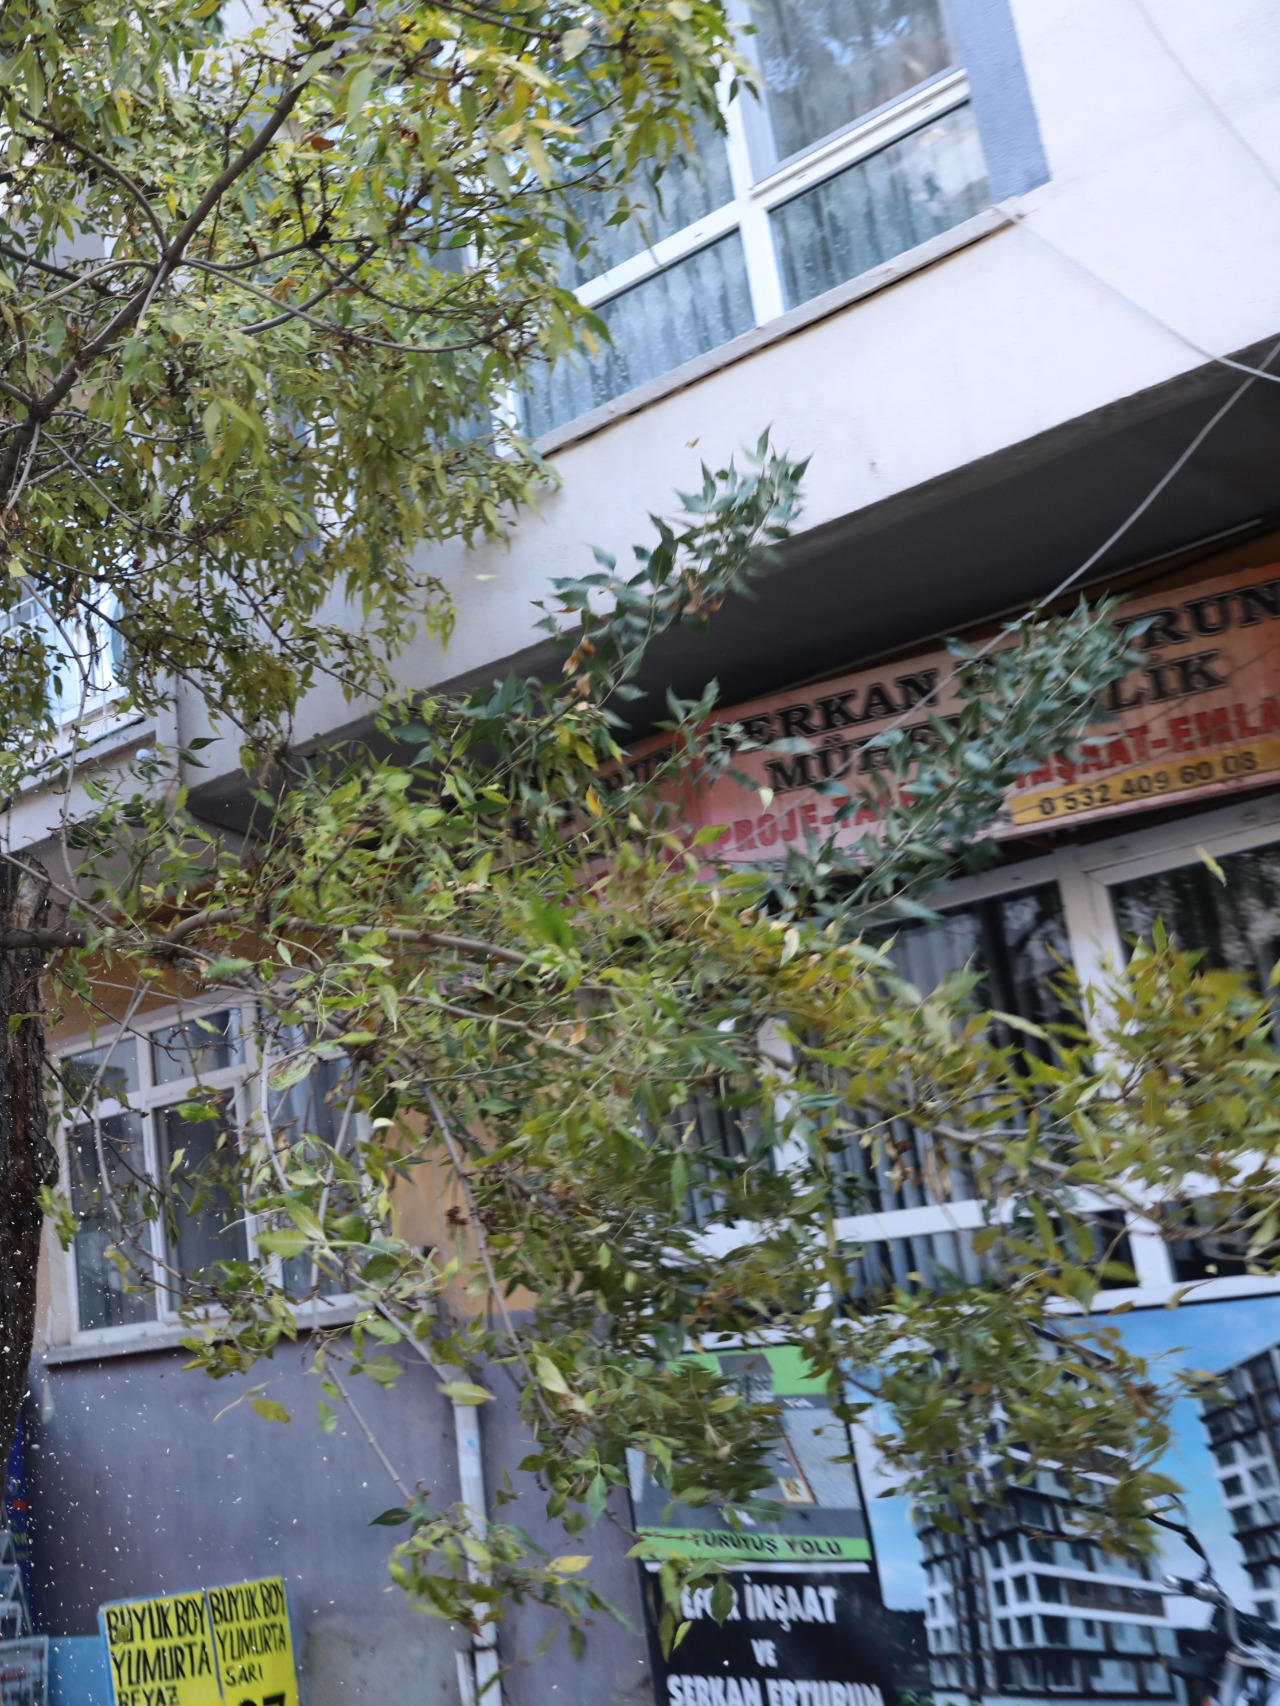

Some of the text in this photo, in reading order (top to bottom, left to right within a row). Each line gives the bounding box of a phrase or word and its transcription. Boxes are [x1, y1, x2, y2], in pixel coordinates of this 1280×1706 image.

[1039, 751, 1260, 816] 0 532 409 60 08
[784, 1536, 842, 1556] YOLU
[174, 1596, 206, 1638] BOY
[259, 1581, 287, 1619] BOY
[743, 1573, 838, 1633] İNŞAAT
[216, 1622, 287, 1663] YUMURTA
[750, 1637, 780, 1668] VE
[110, 1641, 212, 1688] YUMURTA
[225, 1662, 264, 1687] SARI
[666, 1674, 764, 1706] SERKAN
